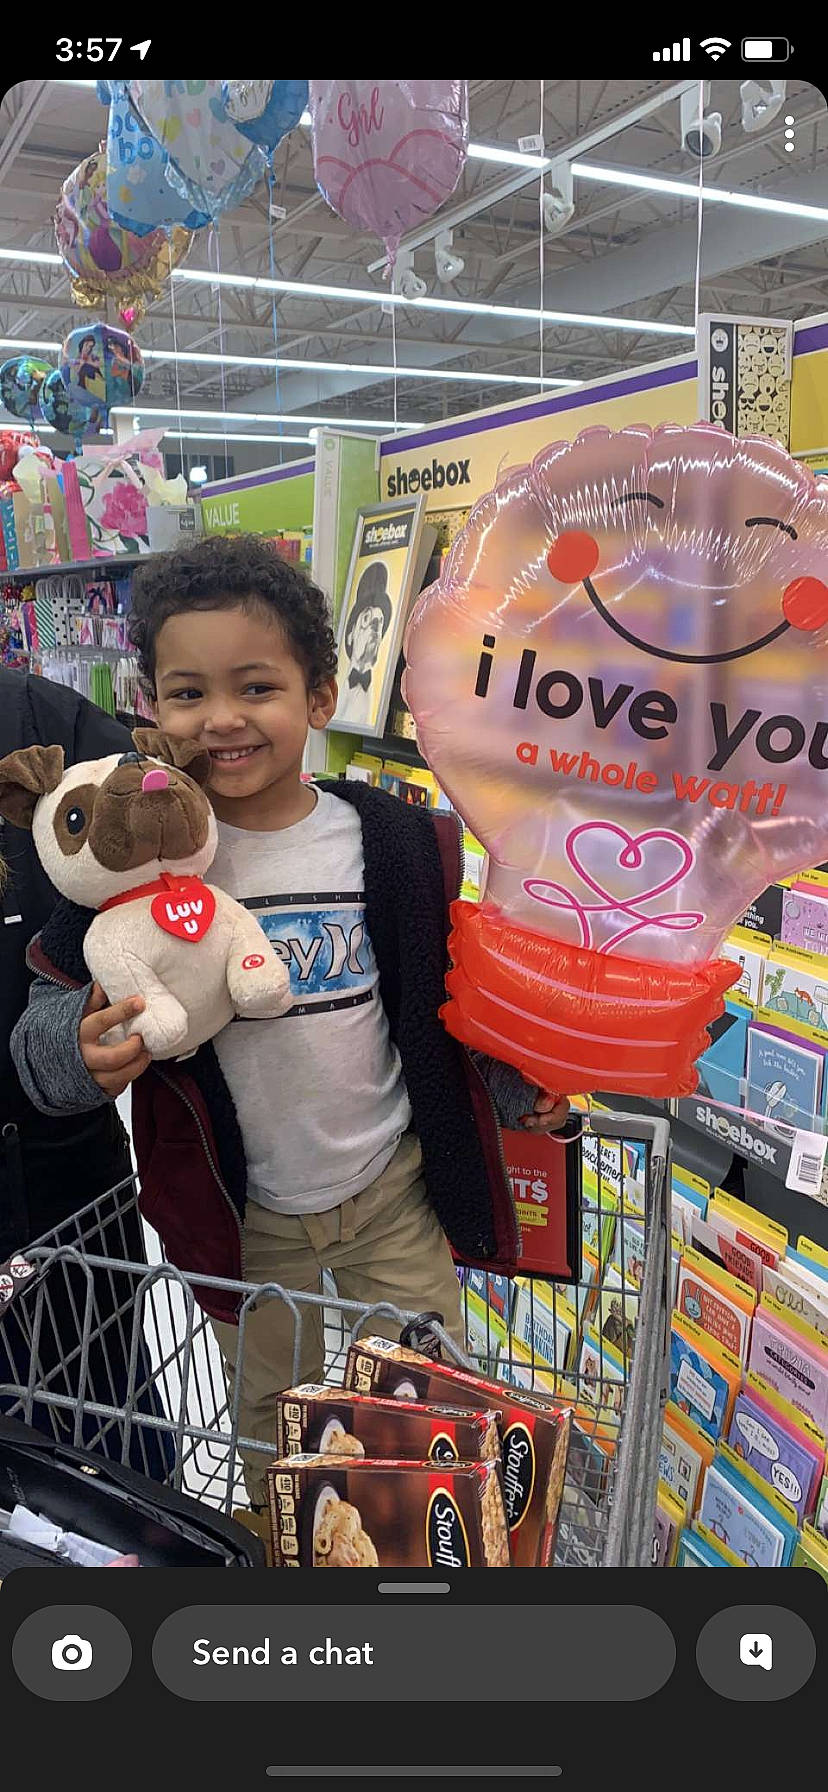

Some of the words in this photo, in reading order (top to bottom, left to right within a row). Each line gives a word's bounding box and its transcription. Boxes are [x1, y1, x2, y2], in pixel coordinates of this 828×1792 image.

[387, 457, 471, 498] shoebox
[205, 503, 241, 528] VALUE
[475, 634, 496, 698] i
[513, 648, 678, 740] love
[516, 742, 539, 765] a
[549, 748, 658, 794] whole
[672, 771, 787, 816] watt!
[165, 899, 203, 922] LUV
[184, 920, 199, 935] U
[696, 1106, 777, 1165] shoebox
[523, 1168, 531, 1176] to
[534, 1169, 547, 1178] the
